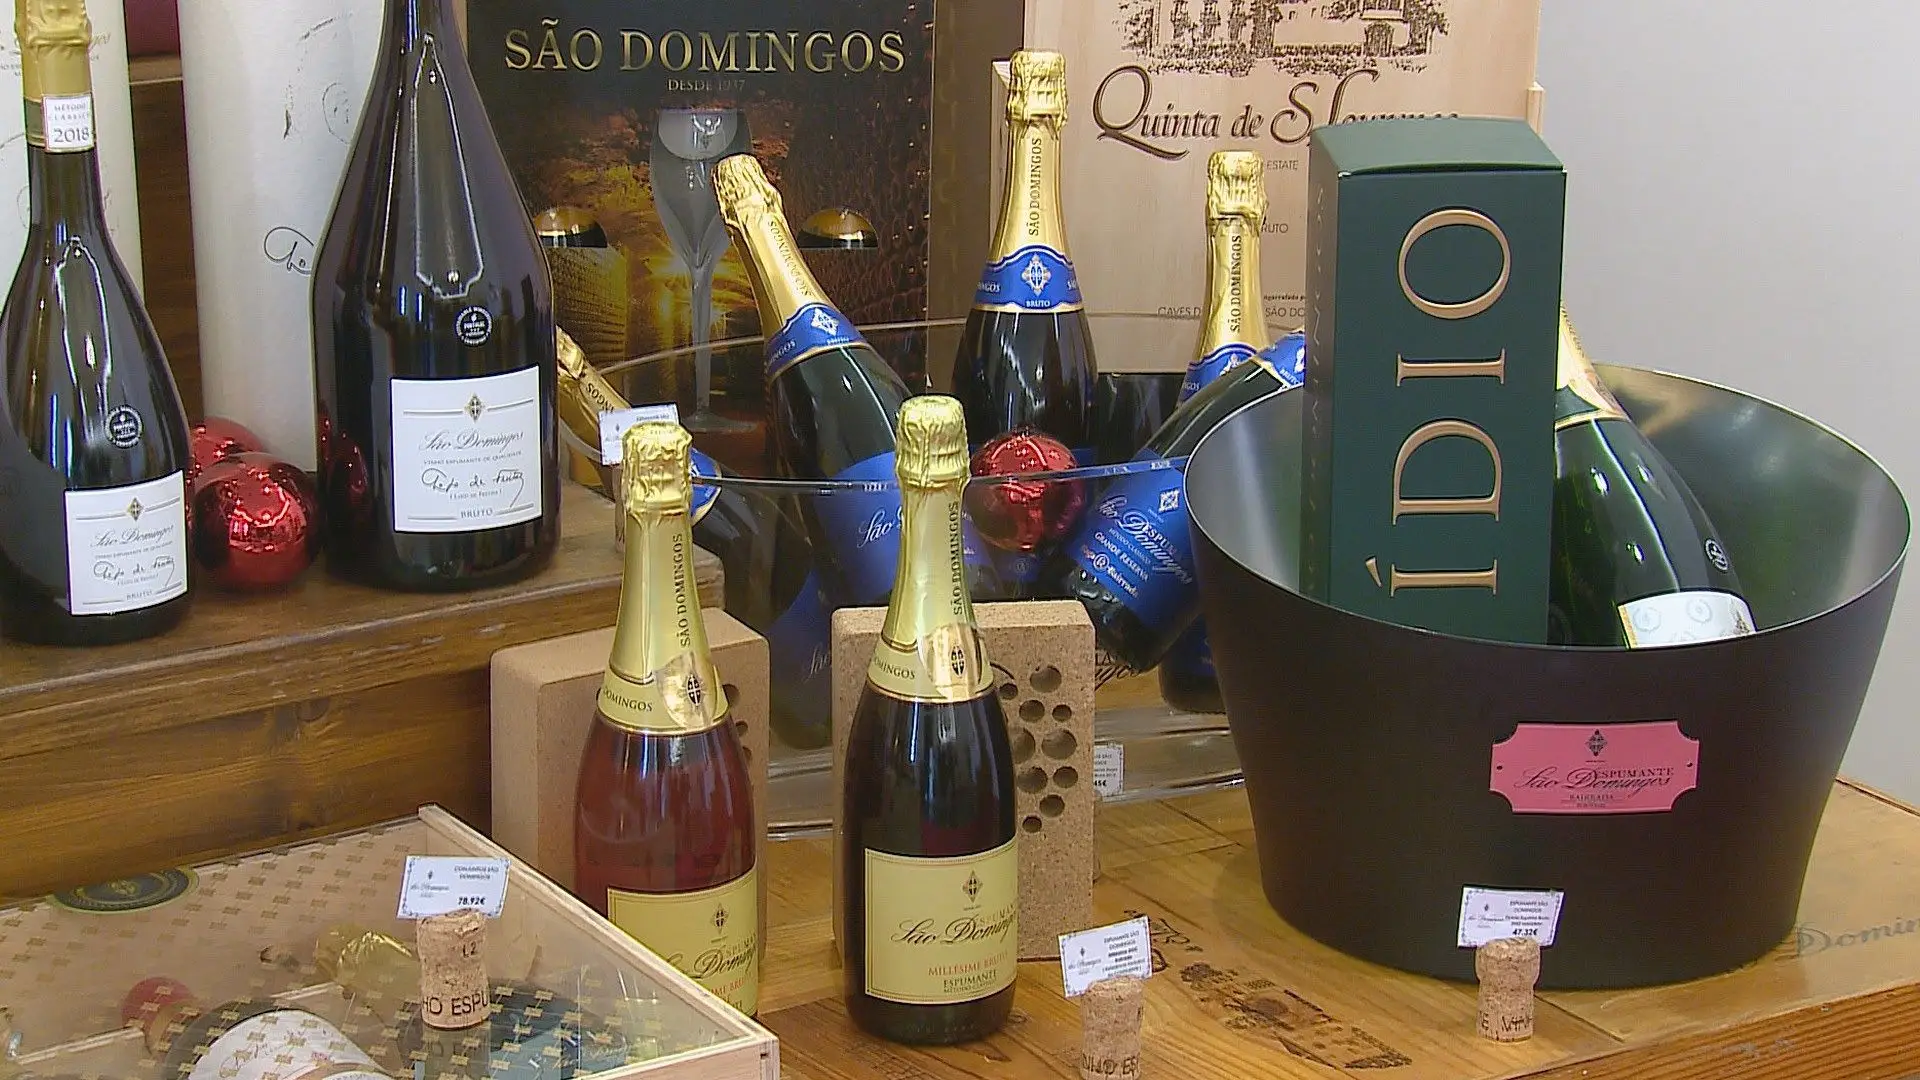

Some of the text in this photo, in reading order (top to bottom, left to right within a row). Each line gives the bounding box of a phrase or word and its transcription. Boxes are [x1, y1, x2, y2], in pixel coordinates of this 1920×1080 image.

[504, 18, 907, 74] SÃO DOMINGOS
[667, 79, 713, 91] DESDE
[1092, 64, 1222, 161] Quinta
[1231, 102, 1265, 139] de
[53, 127, 90, 143] 2018
[1266, 159, 1299, 171] ESTATE
[1025, 137, 1043, 236] SÃO DOMINGOS
[1262, 223, 1290, 234] RUTO
[1227, 234, 1242, 333] SÃO DOMINGOS
[1025, 299, 1051, 308] BRUTO
[1158, 306, 1192, 318] CAVES
[454, 428, 525, 454] Domingos
[460, 508, 494, 519] BRUTO
[857, 510, 894, 549] São
[948, 501, 964, 616] SÃO DOMINGOS
[1093, 530, 1150, 583] GRANDE RESERVA
[671, 533, 692, 648] SÃO DOMINGOS
[1513, 766, 1672, 800] São Domingos
[1598, 766, 1675, 778] ESPUMANTE
[457, 896, 486, 906] 78.92€
[890, 917, 938, 946] São
[1512, 927, 1539, 937] 47.32€
[451, 990, 491, 1017] ESPU
